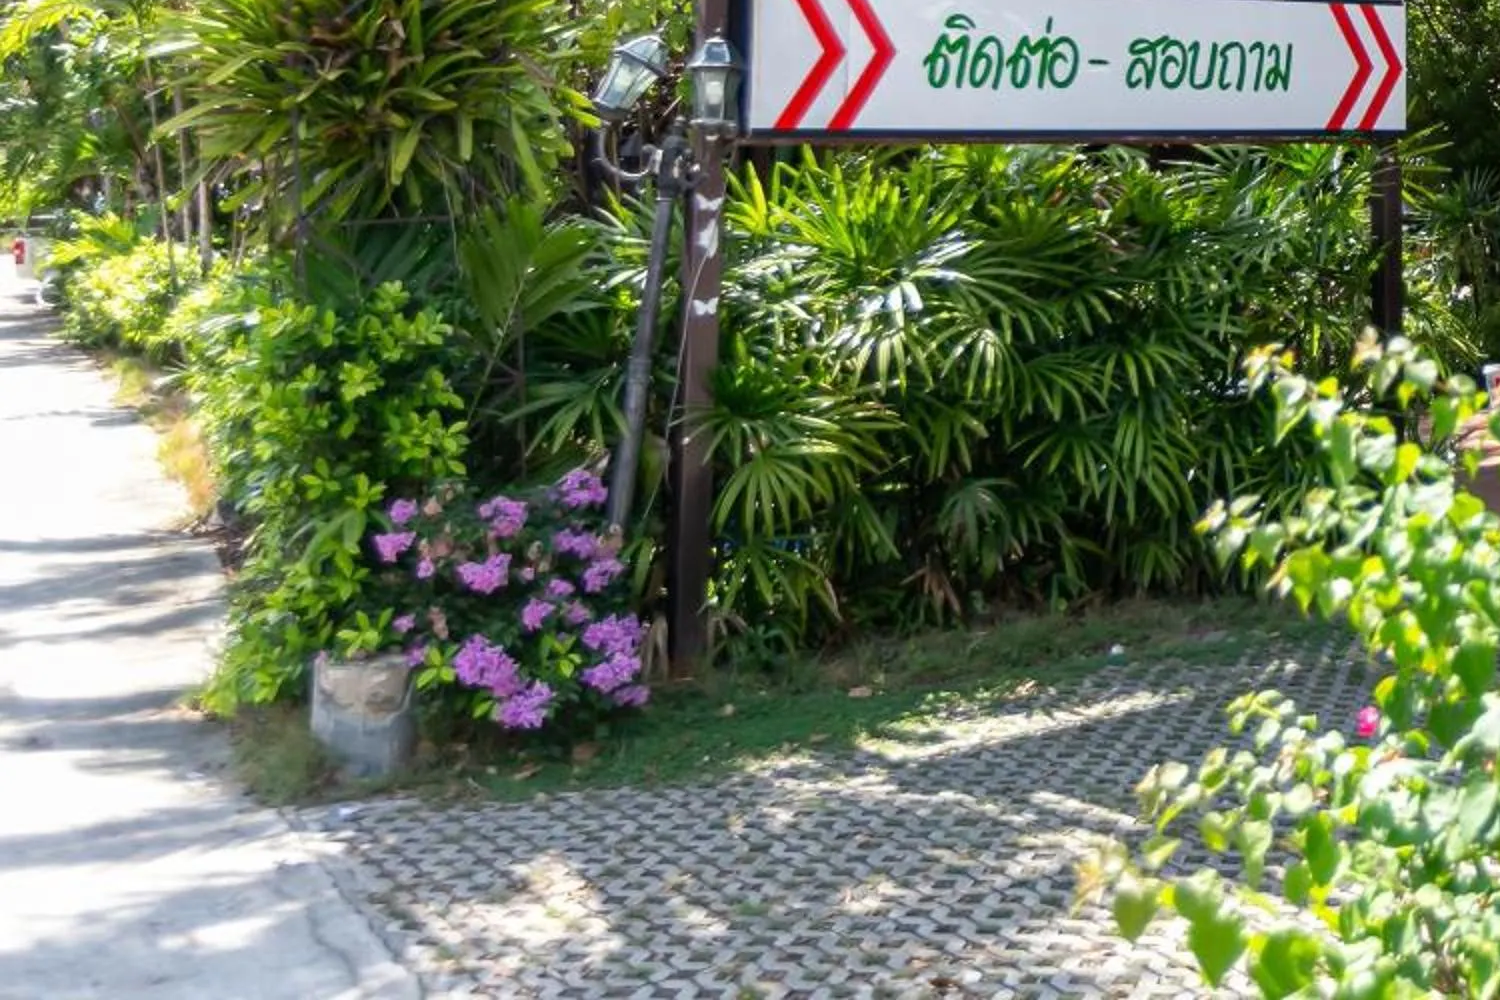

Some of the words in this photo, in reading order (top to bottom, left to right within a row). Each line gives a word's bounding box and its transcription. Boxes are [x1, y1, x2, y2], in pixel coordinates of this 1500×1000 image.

[923, 13, 1080, 90] ติดต่อ
[1125, 35, 1293, 92] สอบถาม
